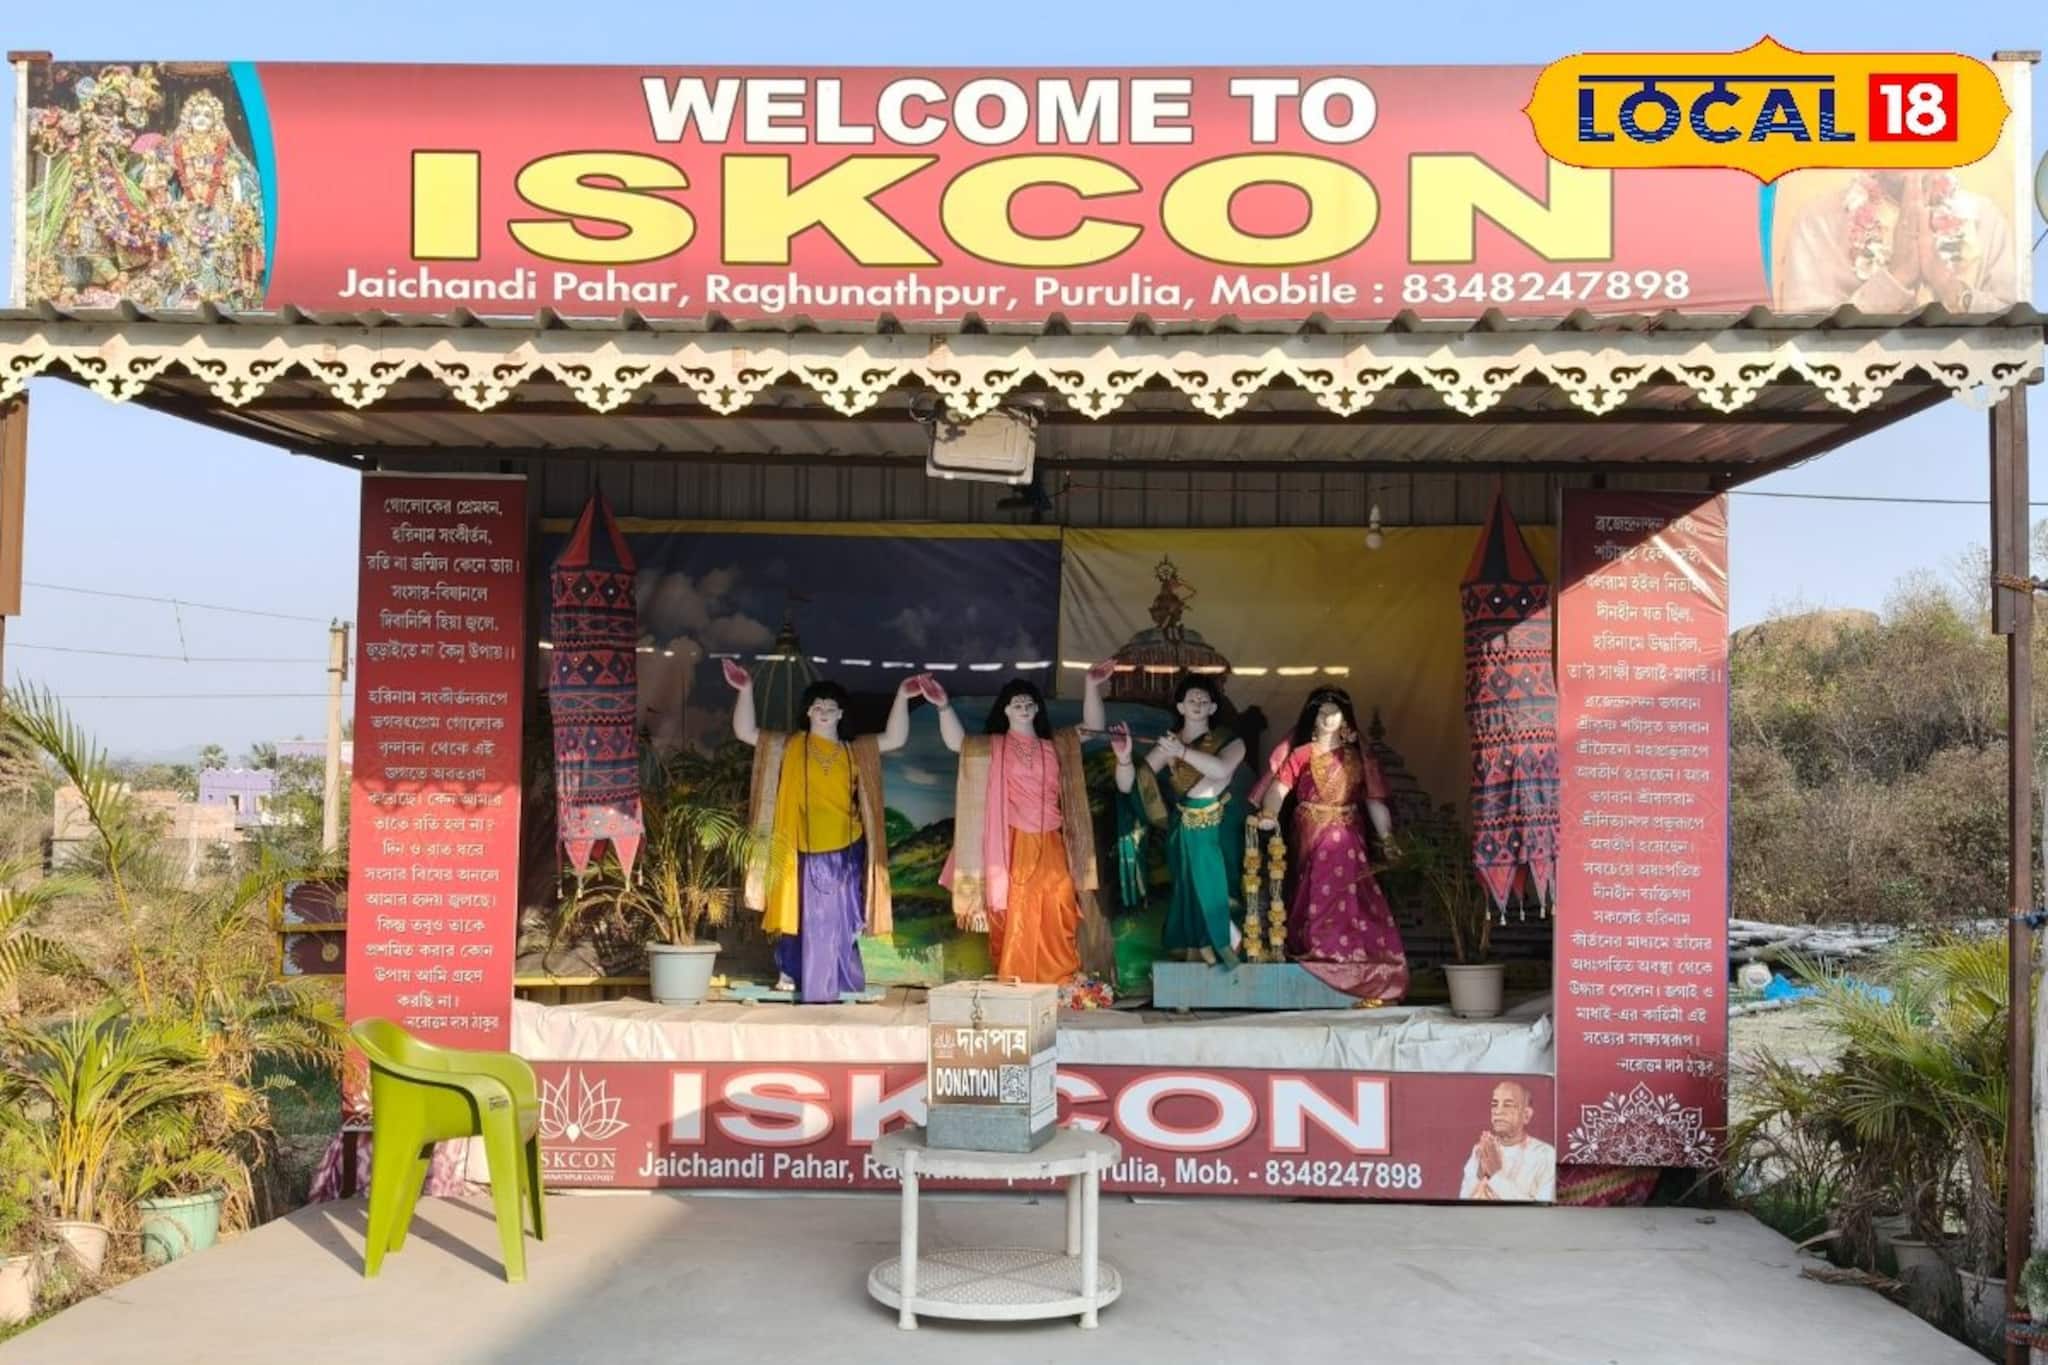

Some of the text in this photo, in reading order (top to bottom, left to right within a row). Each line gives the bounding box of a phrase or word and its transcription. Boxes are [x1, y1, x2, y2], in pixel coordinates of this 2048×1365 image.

[641, 76, 1378, 145] WELCOME TO
[411, 151, 1615, 268] ISKCON
[339, 266, 538, 302] Jaichandi
[553, 270, 690, 308] Pahar,
[706, 274, 1018, 312] Raghunathpur,
[1034, 274, 1194, 310] Purulia,
[1210, 273, 1357, 306] Mobile
[1402, 271, 1690, 303] 8348247898
[392, 522, 435, 543] হরিনাম
[366, 551, 389, 571] রতি
[394, 557, 406, 570] না
[421, 645, 434, 655] না
[368, 686, 416, 704] হরিনাম
[431, 743, 468, 755] থেকে
[472, 740, 496, 757] এই
[366, 895, 407, 905] আমার
[956, 1028, 1027, 1058] দানপাত্র
[936, 1068, 998, 1096] DONATION
[540, 1152, 616, 1168] SKCON
[639, 1142, 765, 1179] Jaichandi
[773, 1152, 854, 1184] Pahar,
[1175, 1157, 1239, 1186] Mob.
[1266, 1160, 1423, 1190] 8348247898
